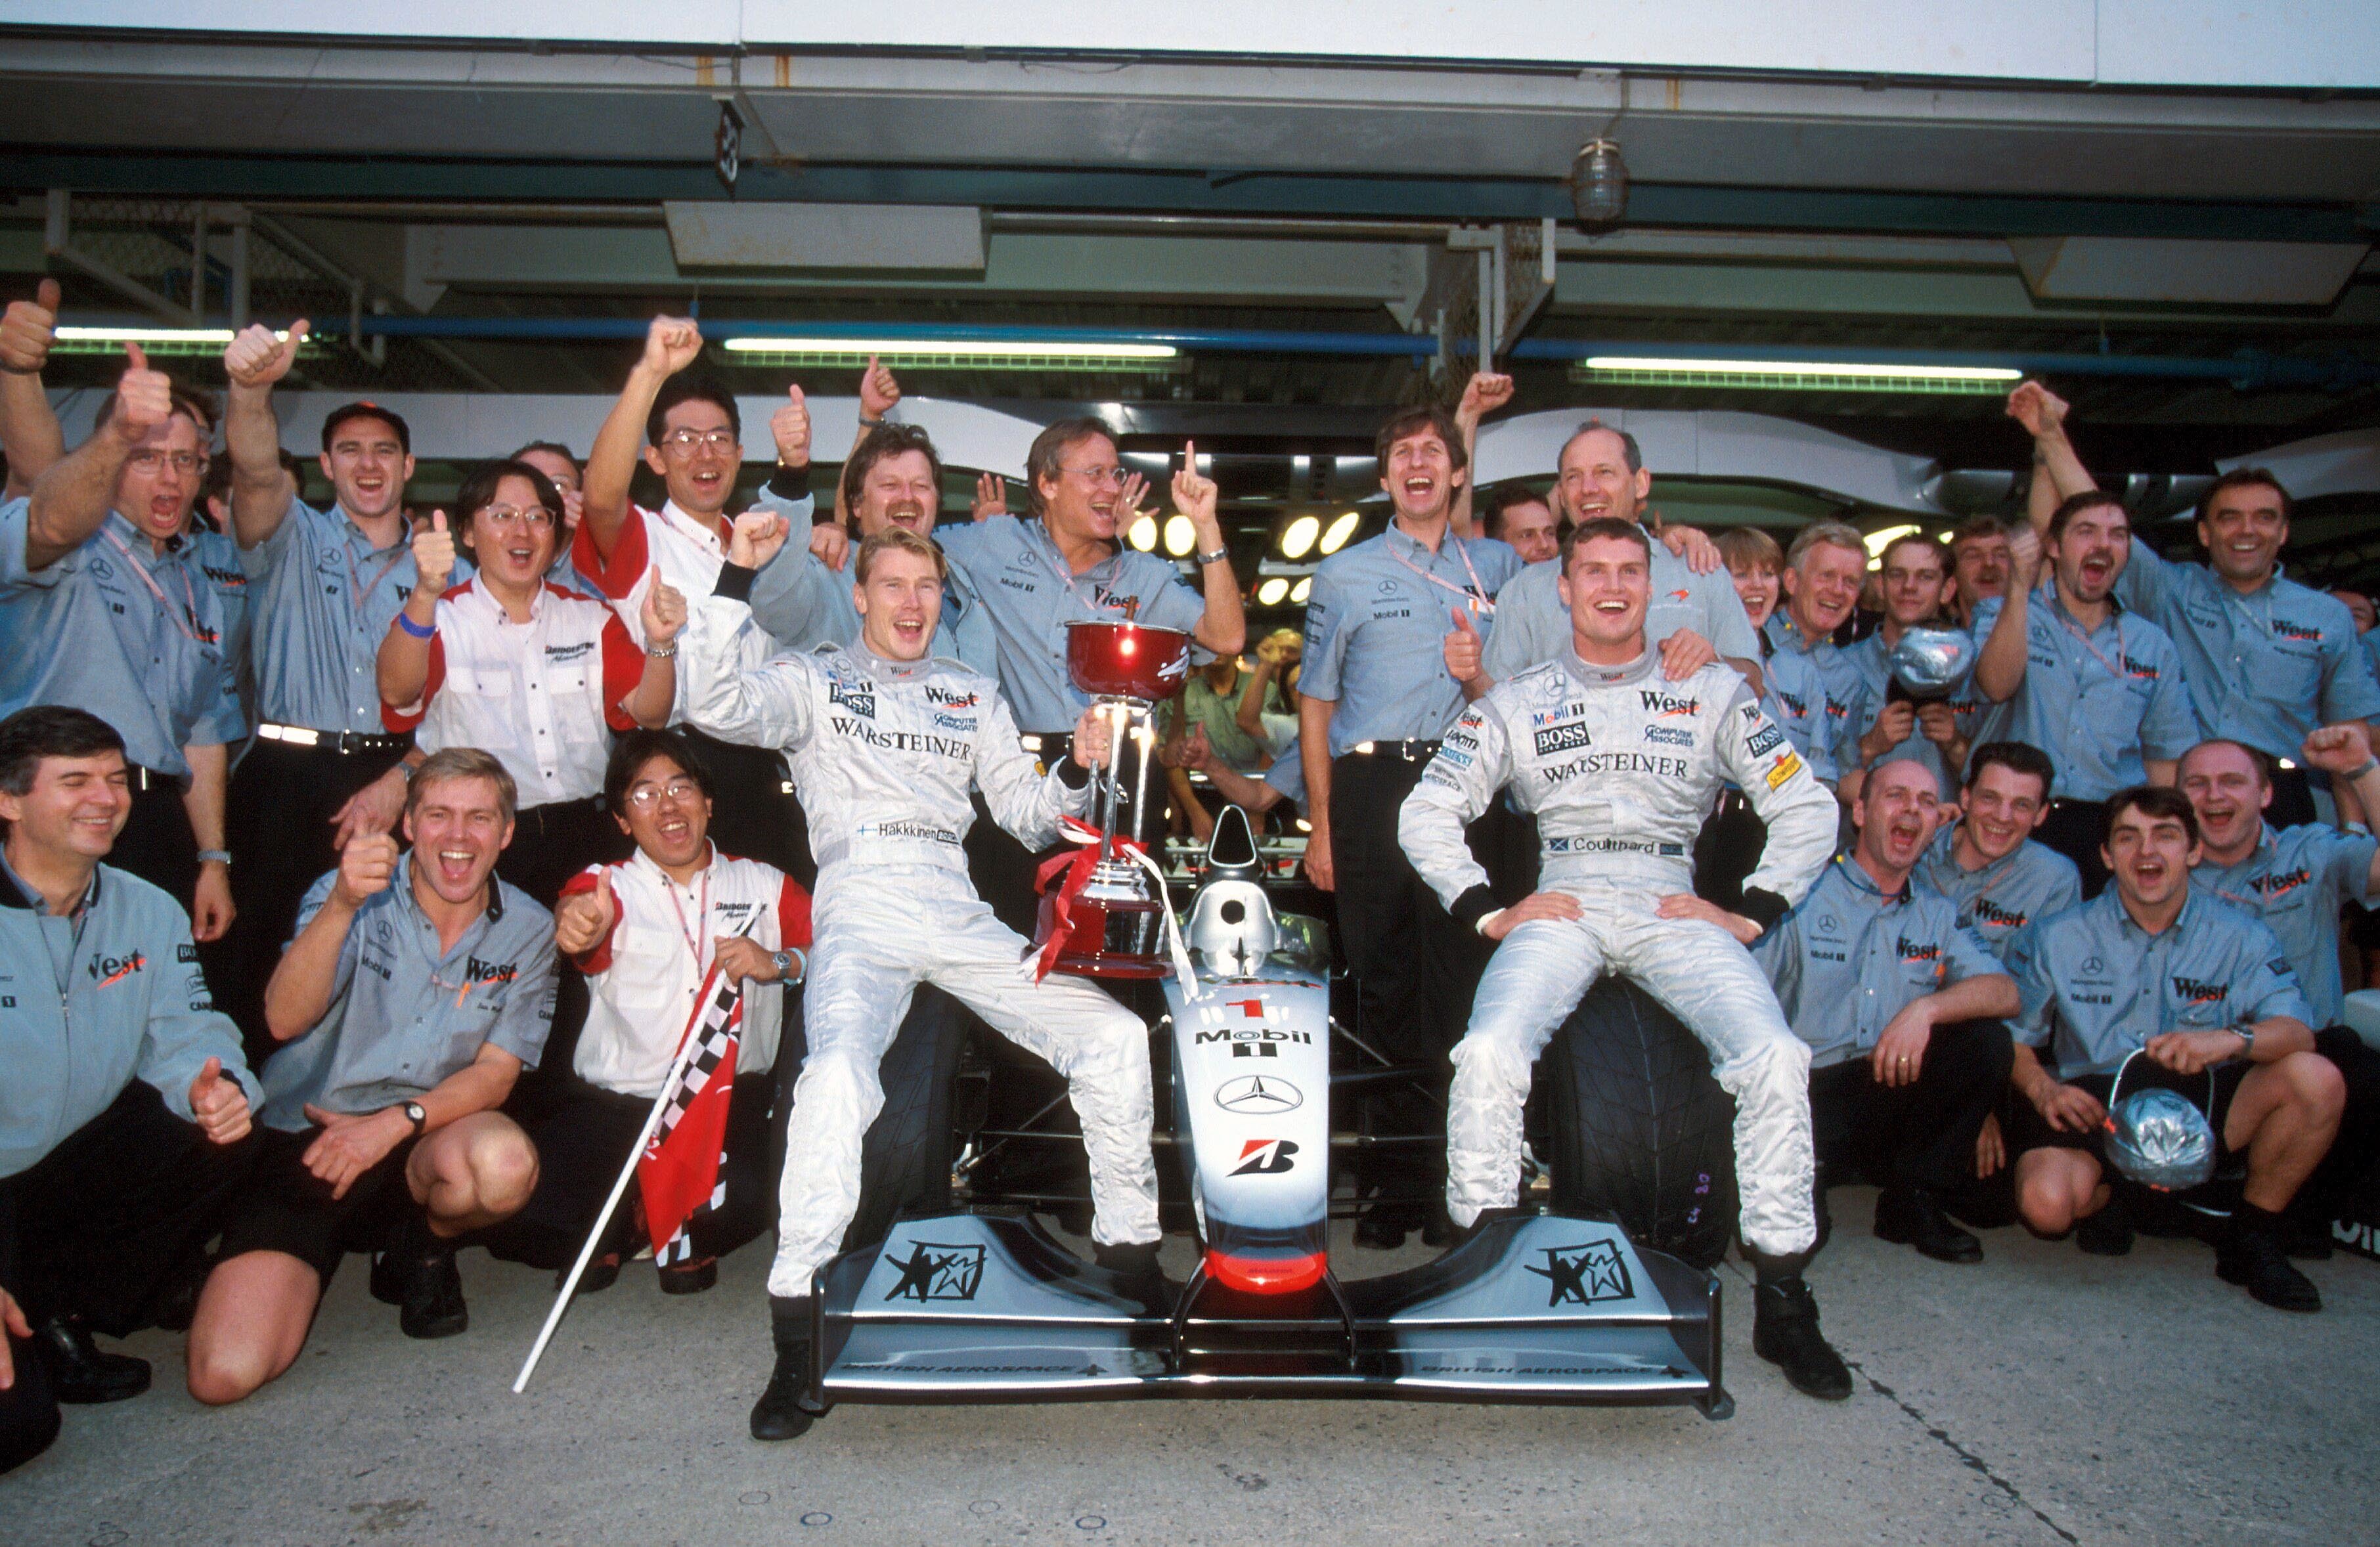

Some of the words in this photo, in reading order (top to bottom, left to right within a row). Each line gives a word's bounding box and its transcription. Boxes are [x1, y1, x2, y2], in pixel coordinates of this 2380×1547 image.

[1374, 611, 1398, 620] Mobil
[924, 685, 977, 707] West
[1640, 689, 1698, 716] West
[1533, 705, 1568, 726] Mobil
[831, 717, 971, 760] WARSTEINER
[1537, 724, 1585, 748] BOSS
[1644, 730, 1694, 747] ASSOCIATES
[1645, 725, 1692, 739] COMPUTER
[1574, 837, 1654, 854] Coulthard
[1975, 899, 2025, 928] West
[467, 955, 517, 984] West
[2172, 976, 2228, 1002] West
[1196, 1029, 1311, 1045] Mobil
